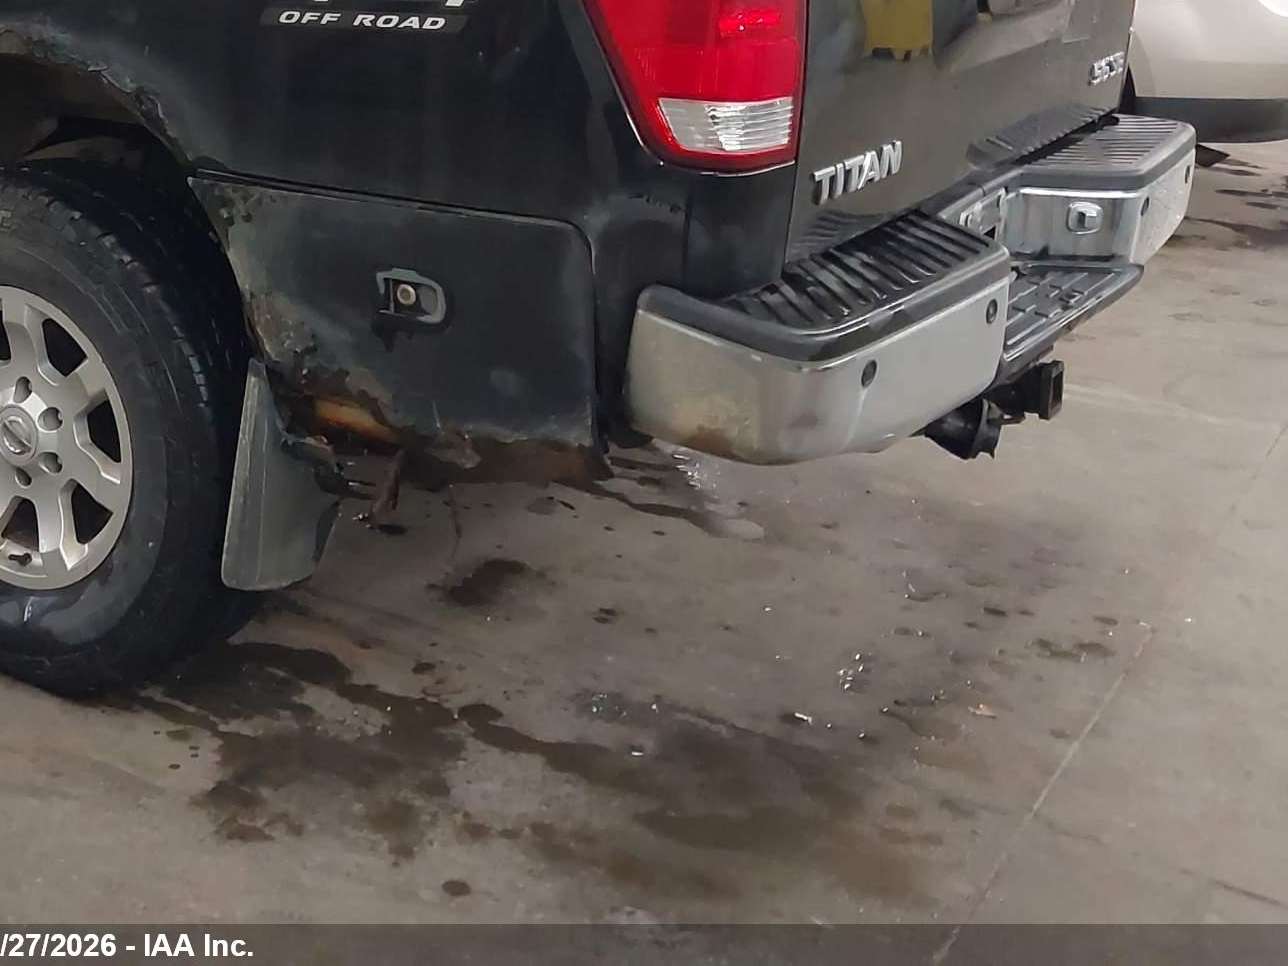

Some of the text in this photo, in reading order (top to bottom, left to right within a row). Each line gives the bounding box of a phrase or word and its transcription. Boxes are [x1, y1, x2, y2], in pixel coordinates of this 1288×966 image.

[279, 10, 446, 30] OFF ROAD
[812, 140, 902, 205] TITAN
